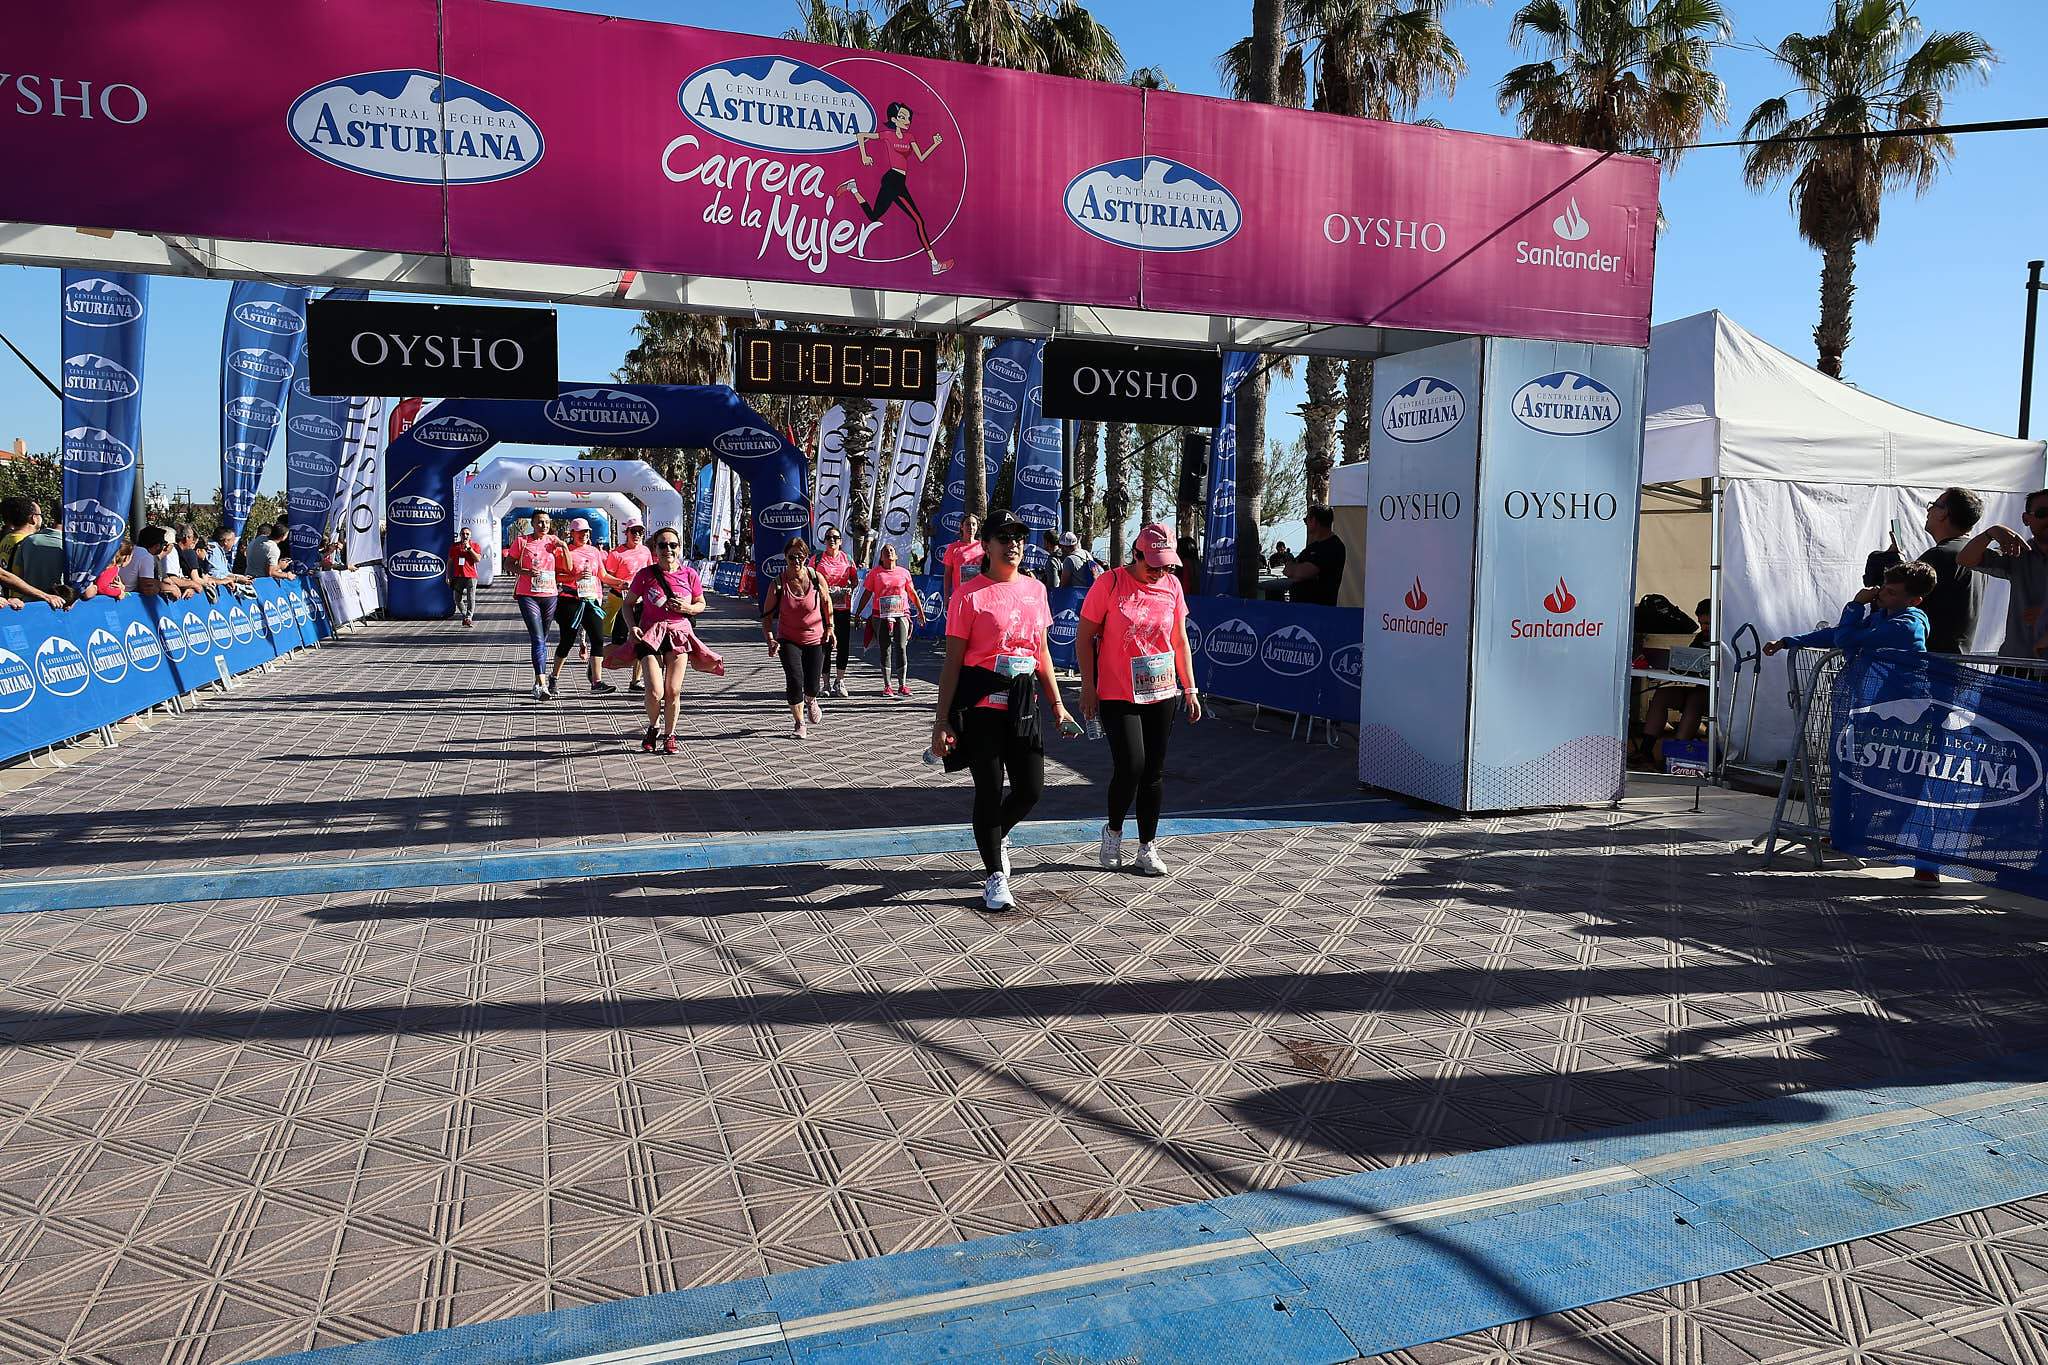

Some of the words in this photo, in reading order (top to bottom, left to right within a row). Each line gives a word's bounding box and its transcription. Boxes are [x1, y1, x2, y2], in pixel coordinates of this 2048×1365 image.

[726, 83, 788, 100] CENTRAL
[794, 92, 857, 108] LECHERA
[349, 103, 429, 121] CENTRAL
[694, 82, 861, 135] ASTURIANA
[309, 102, 527, 162] ASTURIANA
[661, 134, 825, 197] Carrera
[1106, 184, 1162, 199] CENTRAL
[1167, 191, 1224, 205] LECHERA
[1077, 184, 1229, 232] ASTURIANA
[702, 191, 734, 225] de
[740, 191, 762, 228] la
[757, 195, 885, 274] Mujer
[1322, 212, 1447, 253] OYSHO
[1515, 240, 1621, 273] Santander
[350, 331, 524, 371] OYSHO
[750, 339, 922, 389] 01:06:30
[1072, 366, 1198, 402] OYSHO
[1536, 392, 1571, 401] CENTRAL
[553, 400, 651, 425] ASTURIANA
[570, 400, 608, 408] CENTRAL
[983, 395, 1014, 411] STURIANA
[1518, 393, 1613, 421] ASTURIANA
[292, 418, 339, 438] ASTURIANA
[1386, 404, 1459, 430] ASTURIANA
[418, 428, 483, 442] ASTURIANA
[719, 438, 778, 450] ASTURIANA
[527, 464, 617, 484] OYSHO
[884, 400, 938, 536] OYSHO
[390, 506, 441, 520] ASTURIANA
[1004, 513, 1015, 521] A
[1379, 491, 1461, 522] OYSHO
[1504, 490, 1618, 521] OYSHO
[391, 560, 442, 573] ASTURIANA
[1382, 613, 1448, 638] Santander
[1510, 618, 1604, 639] Santander
[1207, 634, 1252, 656] ASTURIANA
[1264, 639, 1315, 667] ASTURIANA
[40, 661, 88, 685] ASTURIANA
[1871, 727, 1938, 746] CENTRAL
[1944, 736, 2018, 759] LECHERA
[1840, 724, 2020, 792] ASTURIANA
